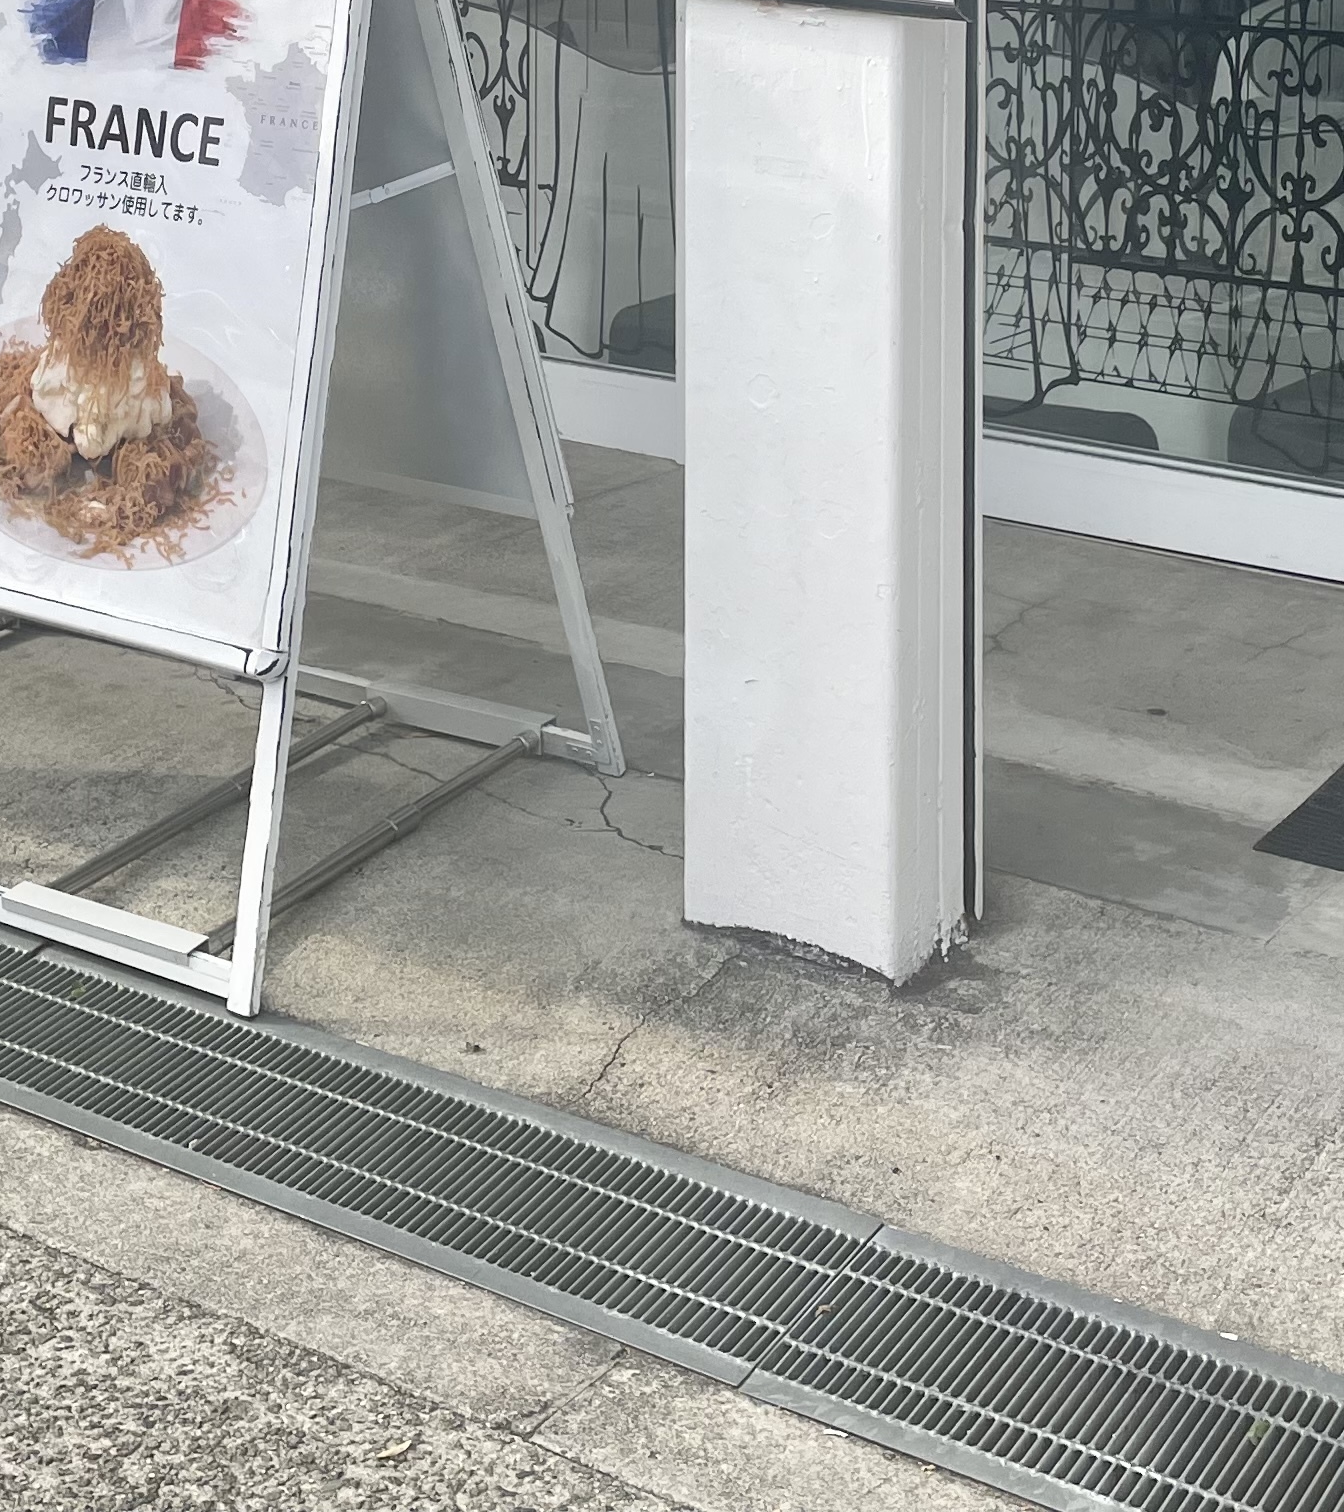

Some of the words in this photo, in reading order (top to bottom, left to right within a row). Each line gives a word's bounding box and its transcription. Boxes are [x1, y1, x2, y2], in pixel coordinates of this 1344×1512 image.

[45, 96, 225, 167] FRANCE
[260, 114, 319, 131] FRANCE
[80, 164, 169, 196] フランス直輸入
[46, 184, 204, 227] クロワッサン使用してます。
